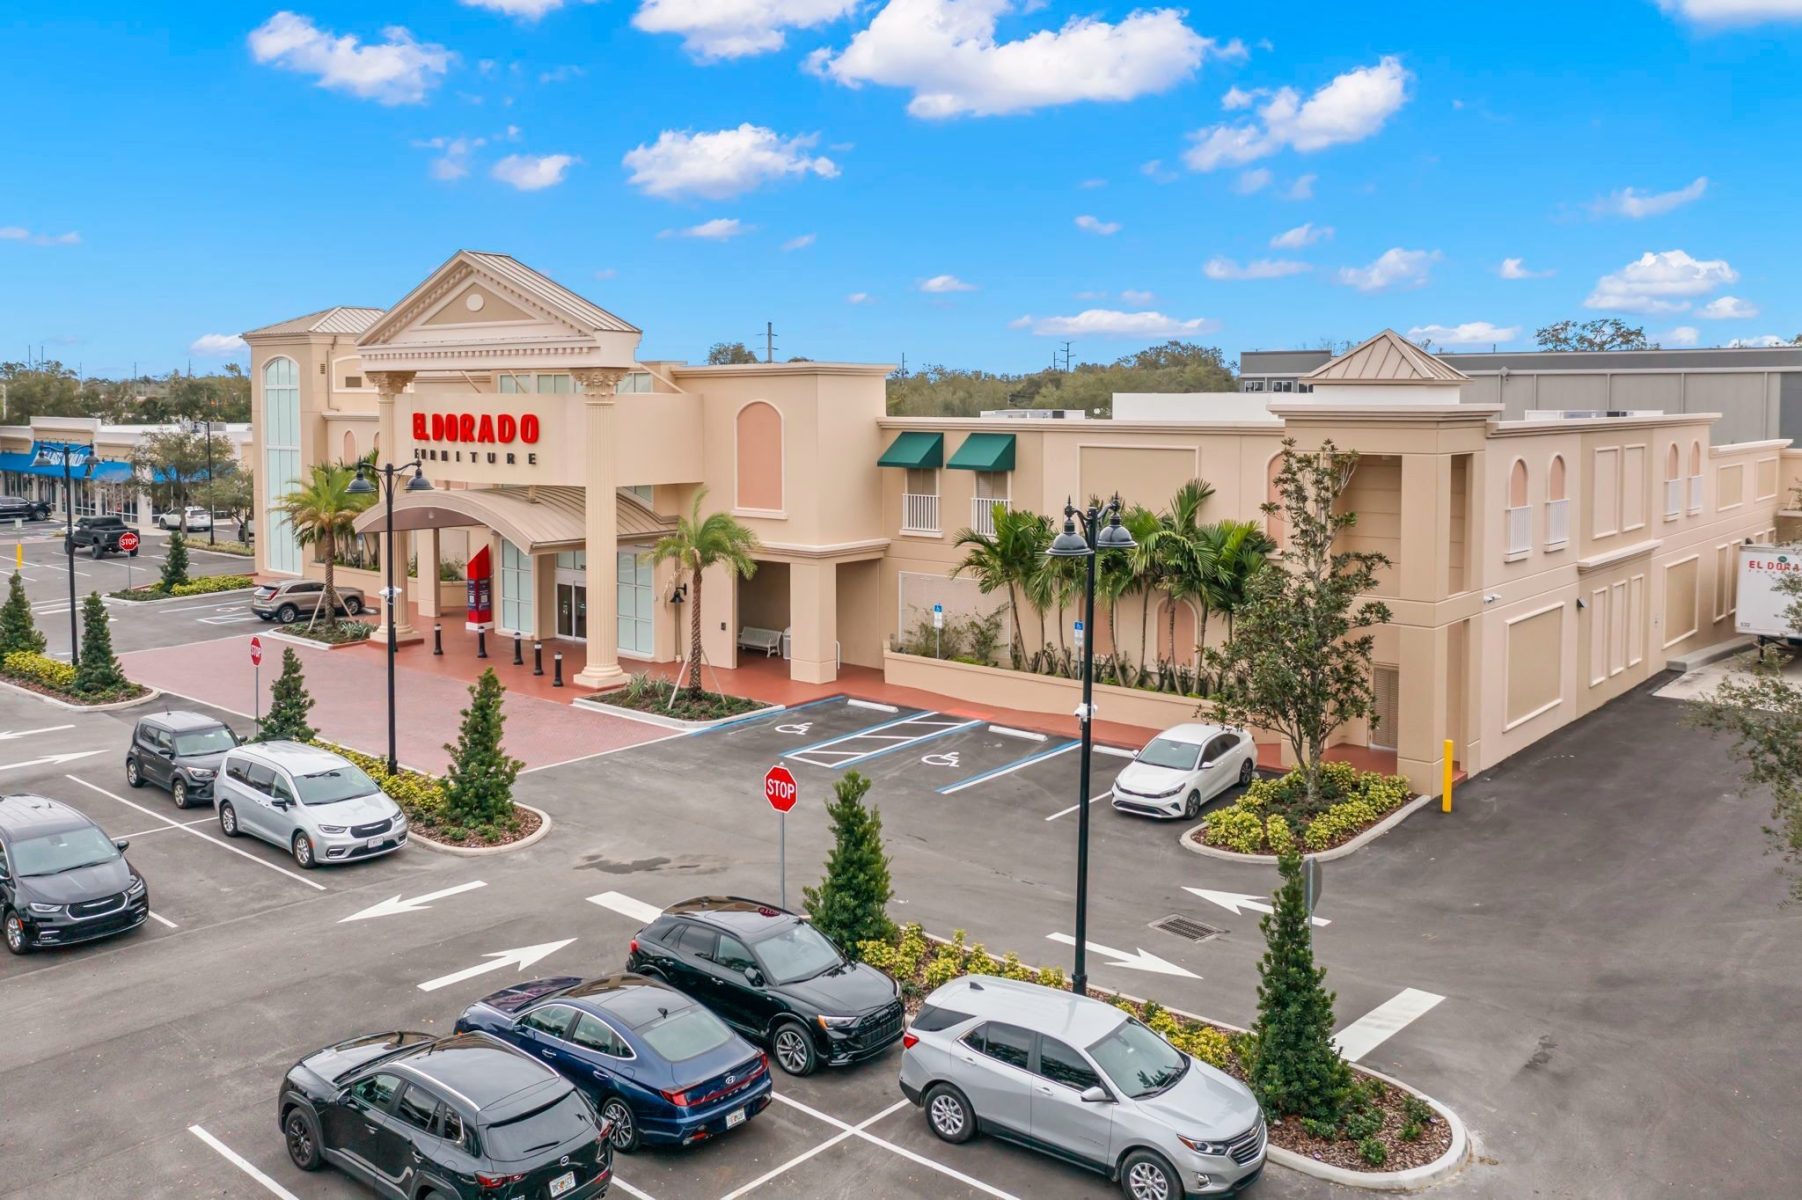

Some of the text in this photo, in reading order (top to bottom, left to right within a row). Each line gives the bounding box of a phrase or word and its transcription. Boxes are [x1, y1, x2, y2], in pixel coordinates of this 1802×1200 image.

[414, 448, 537, 465] FURNITURE
[121, 538, 137, 546] STOP
[1748, 560, 1763, 570] EL
[767, 778, 795, 800] STOP
